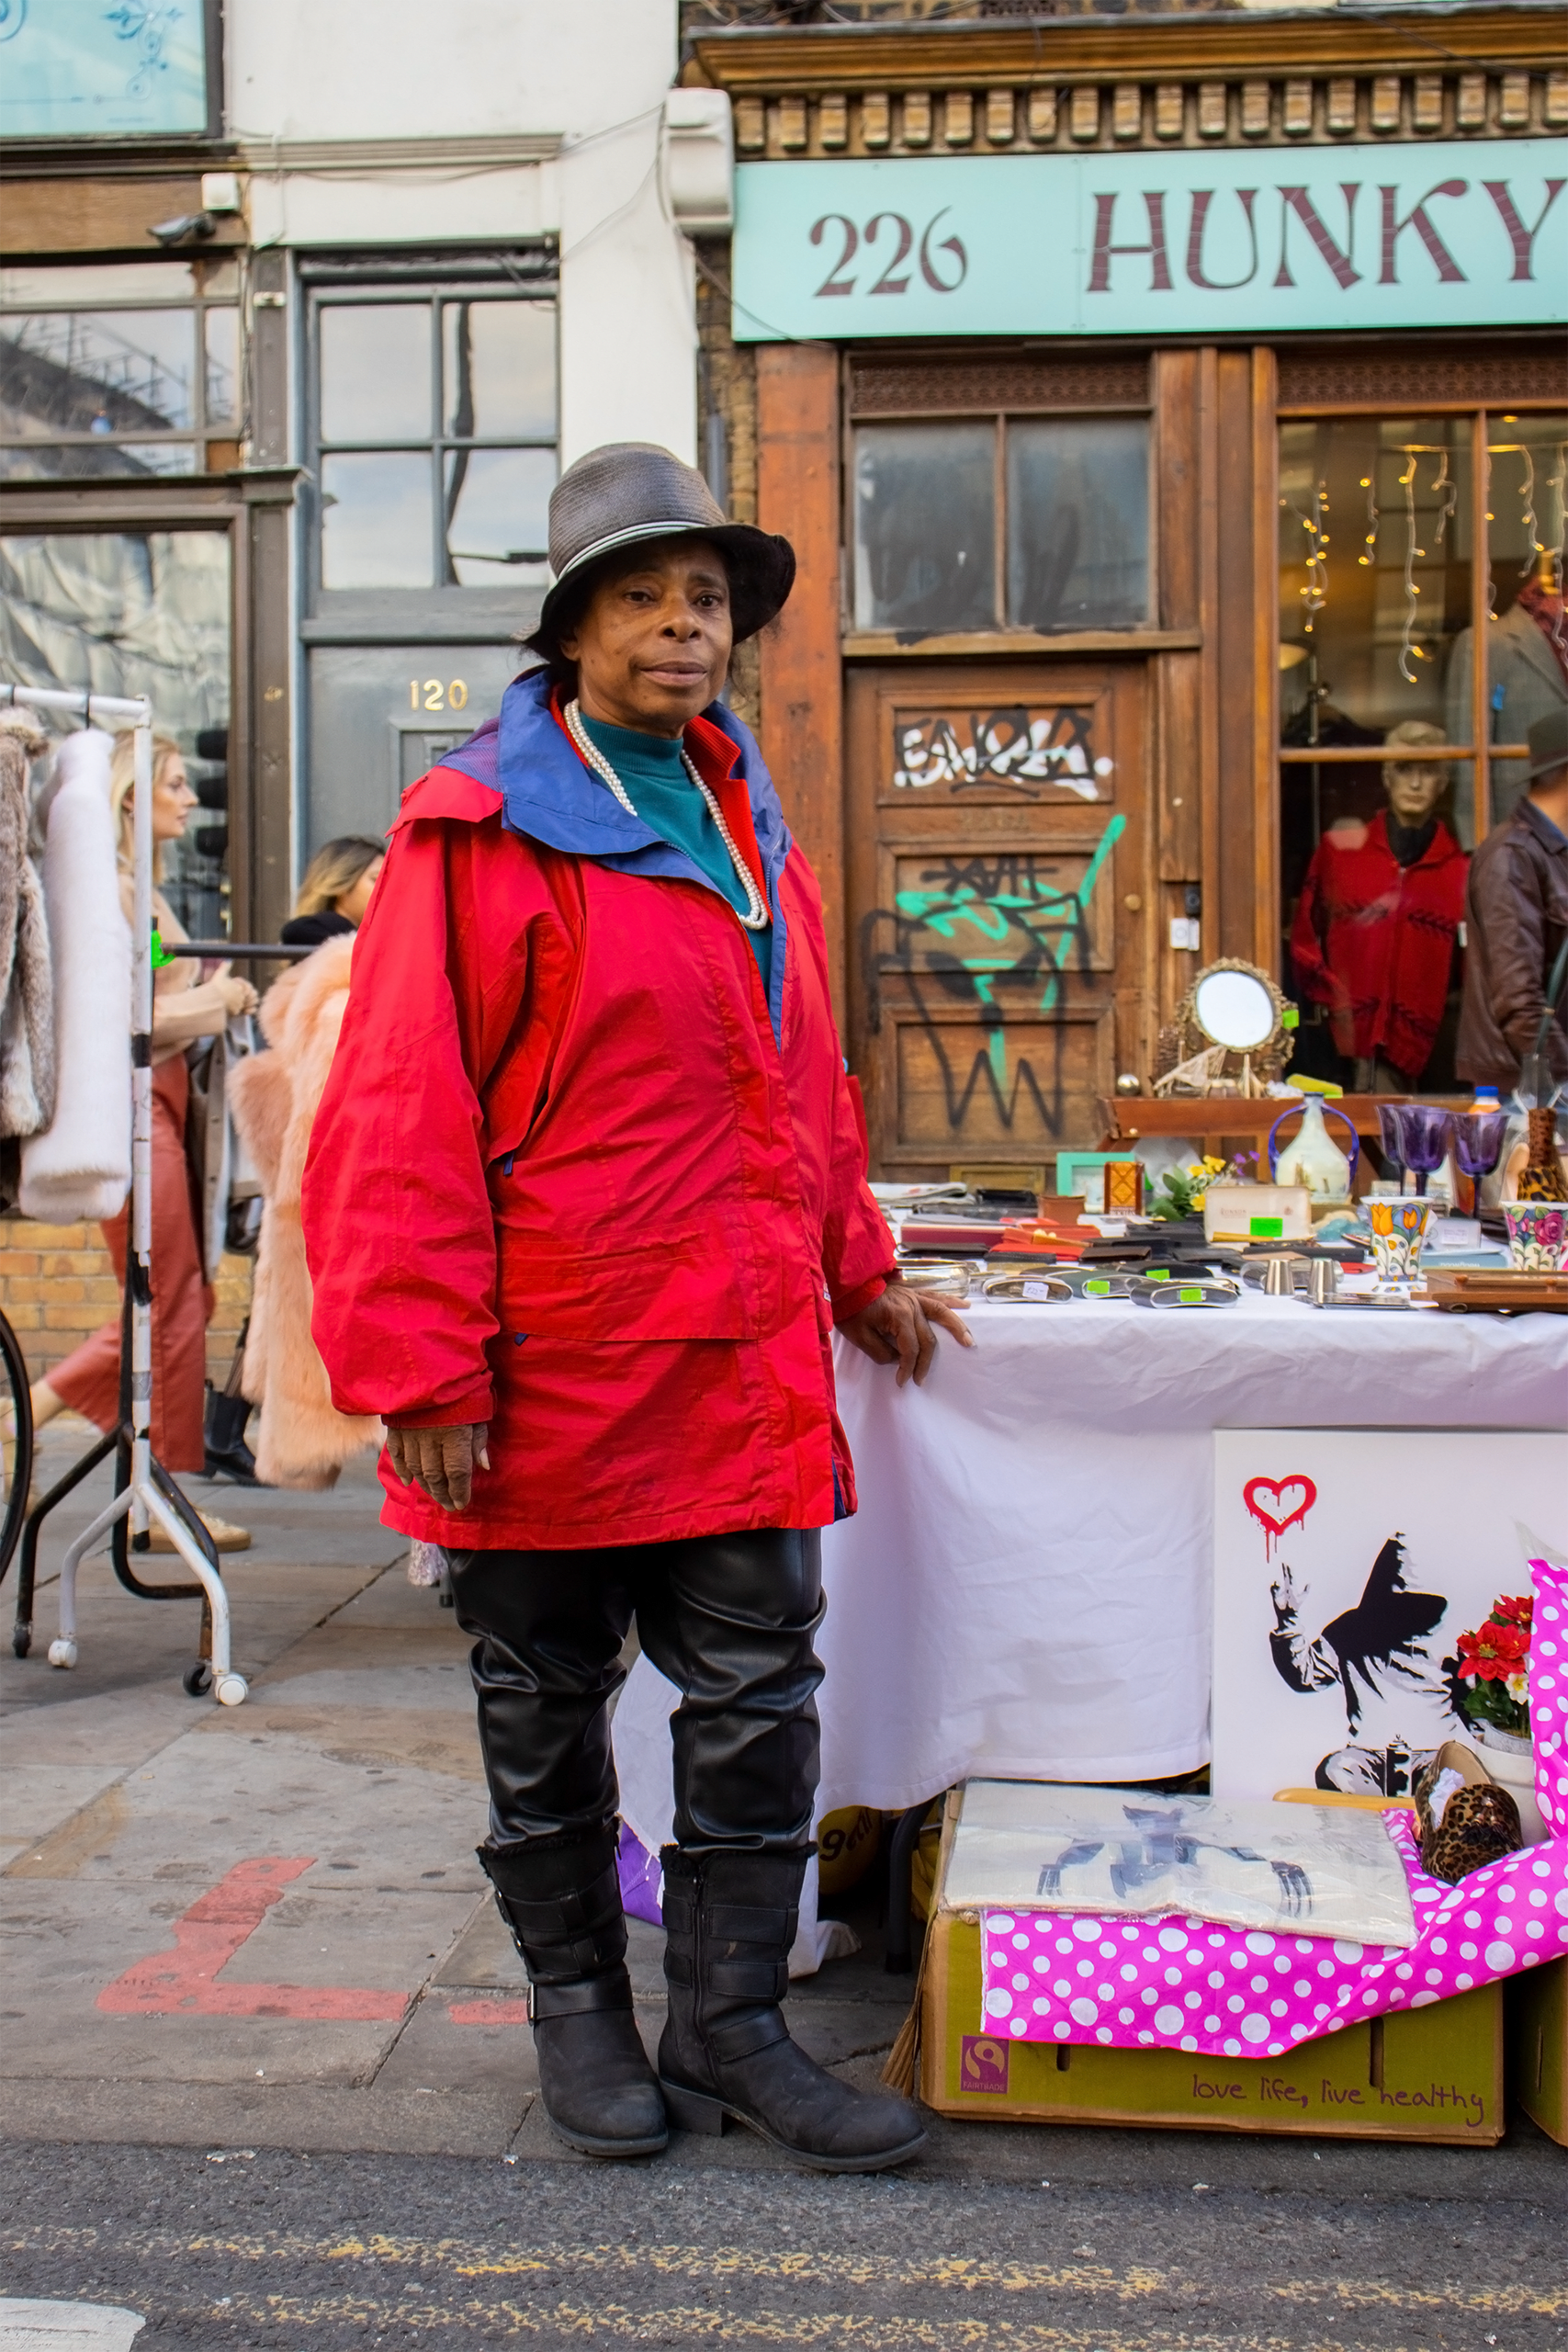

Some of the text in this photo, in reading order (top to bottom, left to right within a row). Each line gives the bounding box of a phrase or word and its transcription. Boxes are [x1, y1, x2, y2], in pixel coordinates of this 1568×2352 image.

[809, 177, 1568, 298] 226 HUNKY
[411, 679, 468, 711] 120
[963, 2081, 1005, 2092] FAIRTRADE
[1192, 2074, 1484, 2128] love life, live healthy
